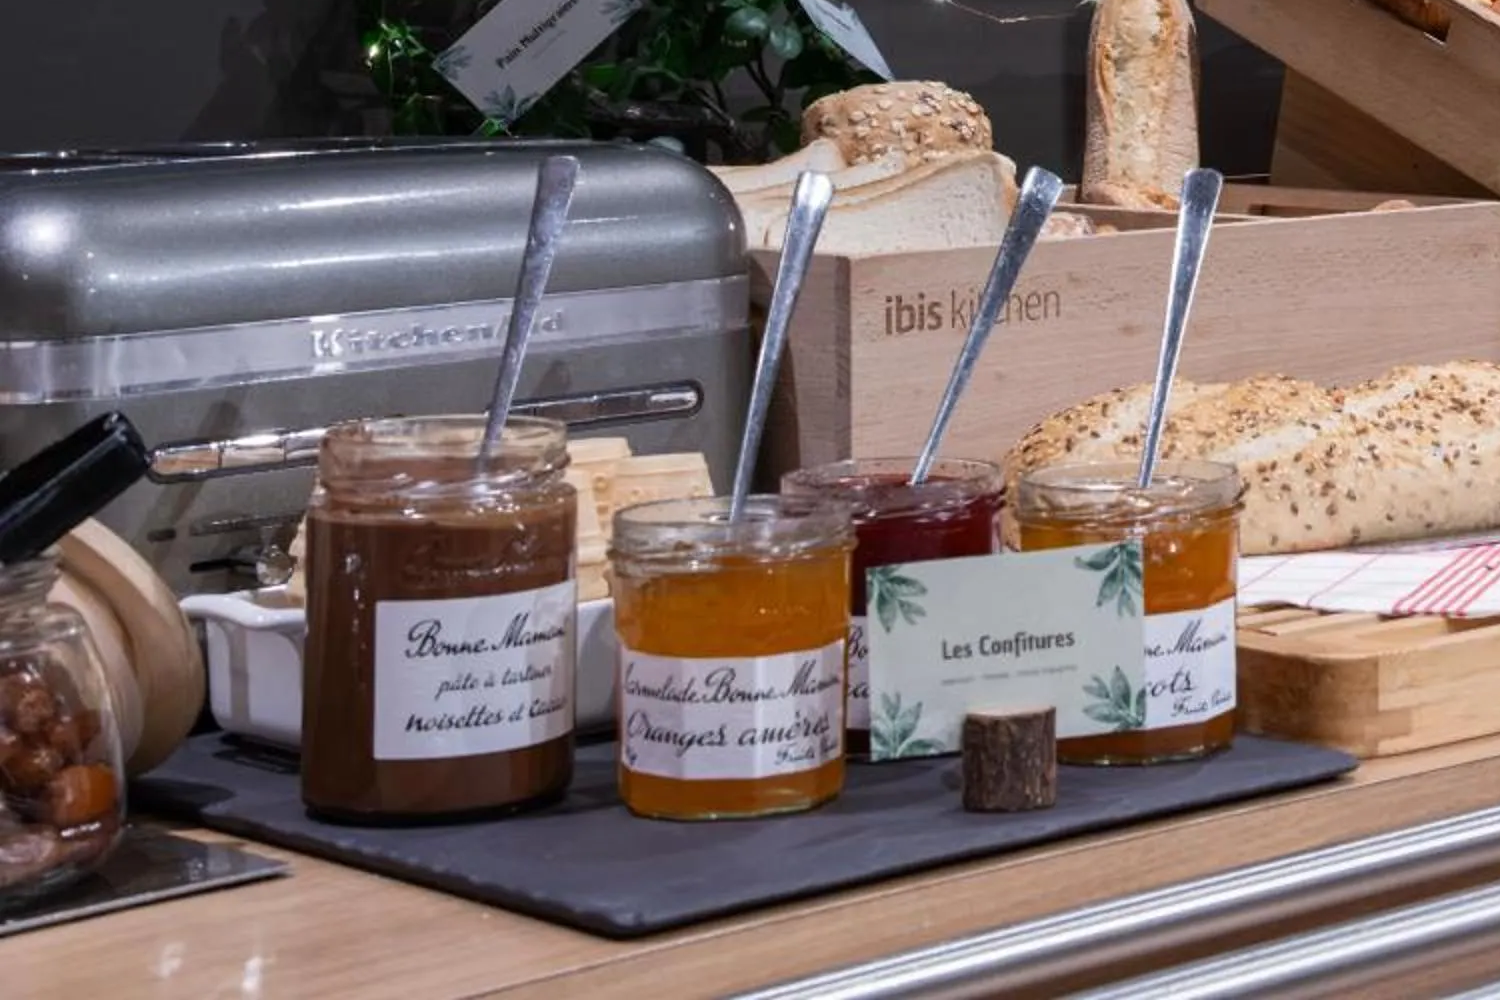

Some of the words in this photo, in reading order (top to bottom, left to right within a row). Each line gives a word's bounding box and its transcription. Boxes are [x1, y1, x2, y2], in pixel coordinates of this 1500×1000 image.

[885, 292, 943, 335] ibis
[951, 287, 1061, 330] kihen
[404, 617, 488, 659] Bonne
[941, 639, 973, 661] Les
[978, 630, 1077, 658] Confitures
[702, 665, 775, 705] Bonne
[404, 704, 503, 733] noisettes
[626, 708, 728, 759] Oranges
